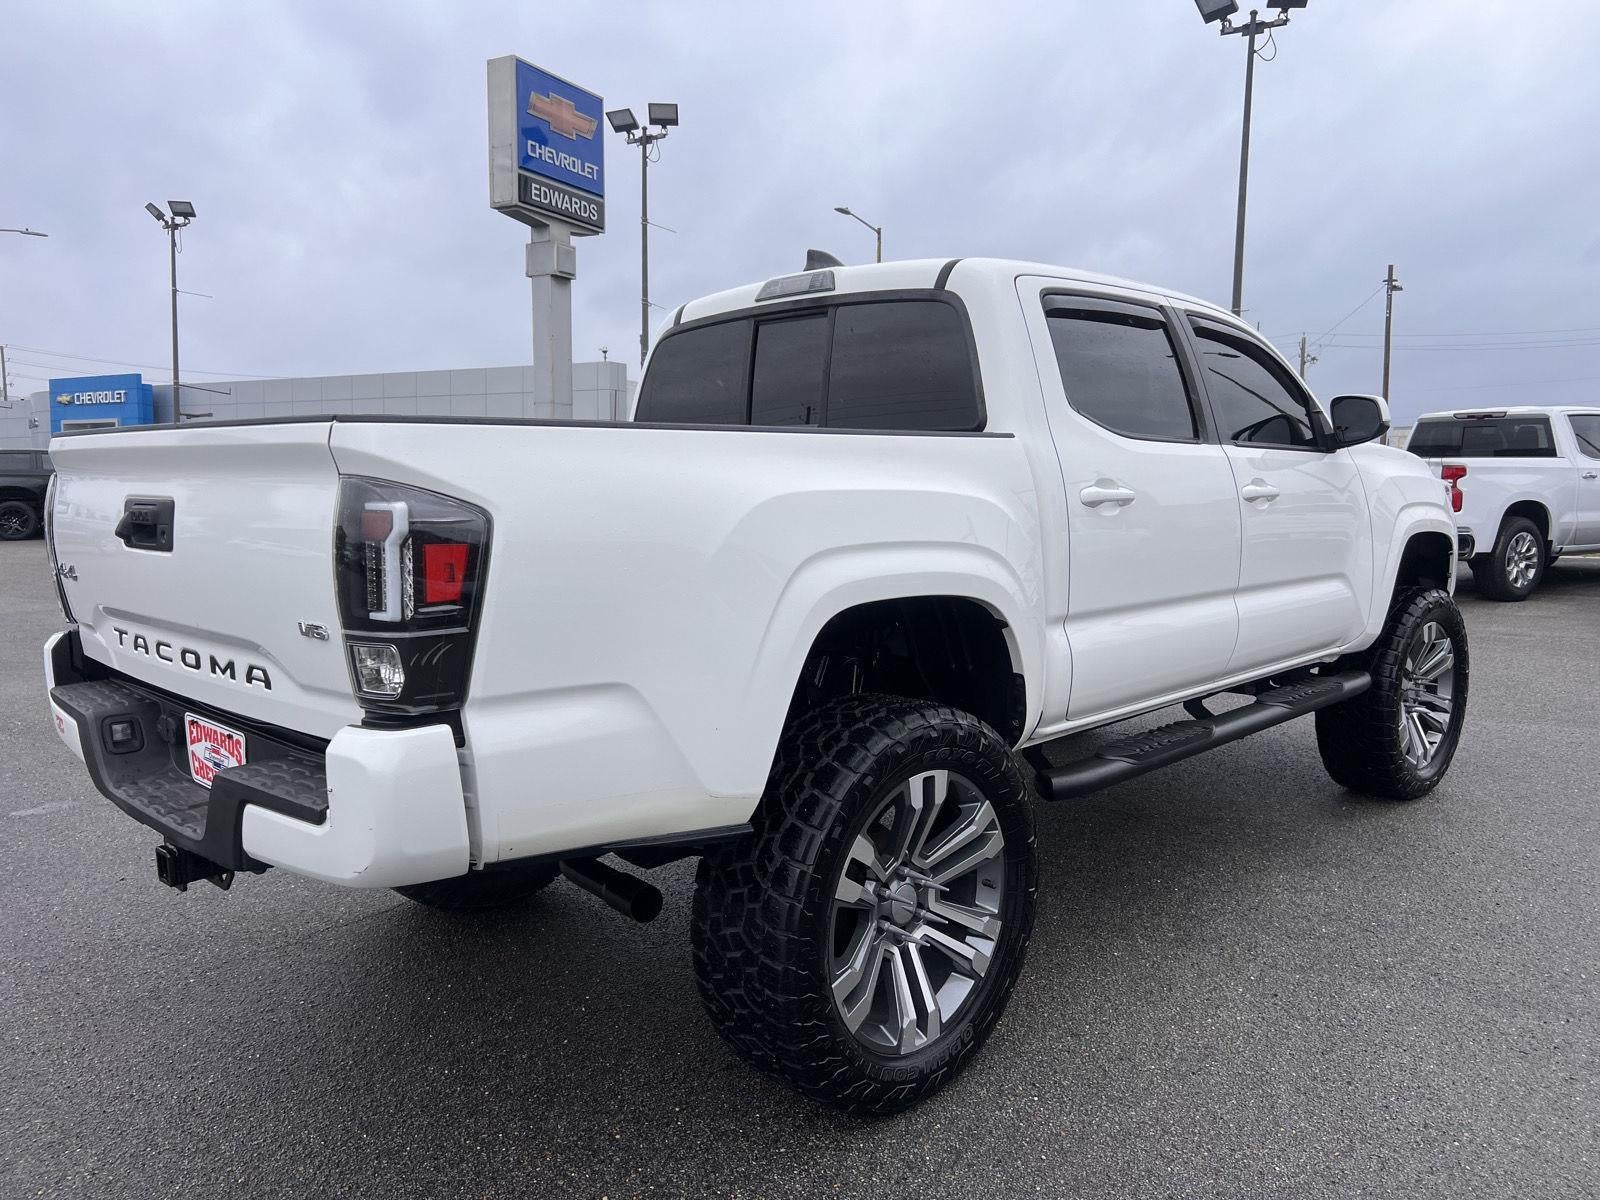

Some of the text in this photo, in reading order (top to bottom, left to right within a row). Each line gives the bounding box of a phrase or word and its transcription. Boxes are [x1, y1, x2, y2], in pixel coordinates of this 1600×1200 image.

[527, 140, 599, 181] CHEVROLET
[531, 182, 598, 221] EDWARDS
[74, 390, 126, 405] CHEVROLET
[297, 621, 330, 641] V6
[113, 626, 272, 691] TACOMA
[188, 720, 242, 766] EDWARDS
[191, 749, 217, 782] CHE
